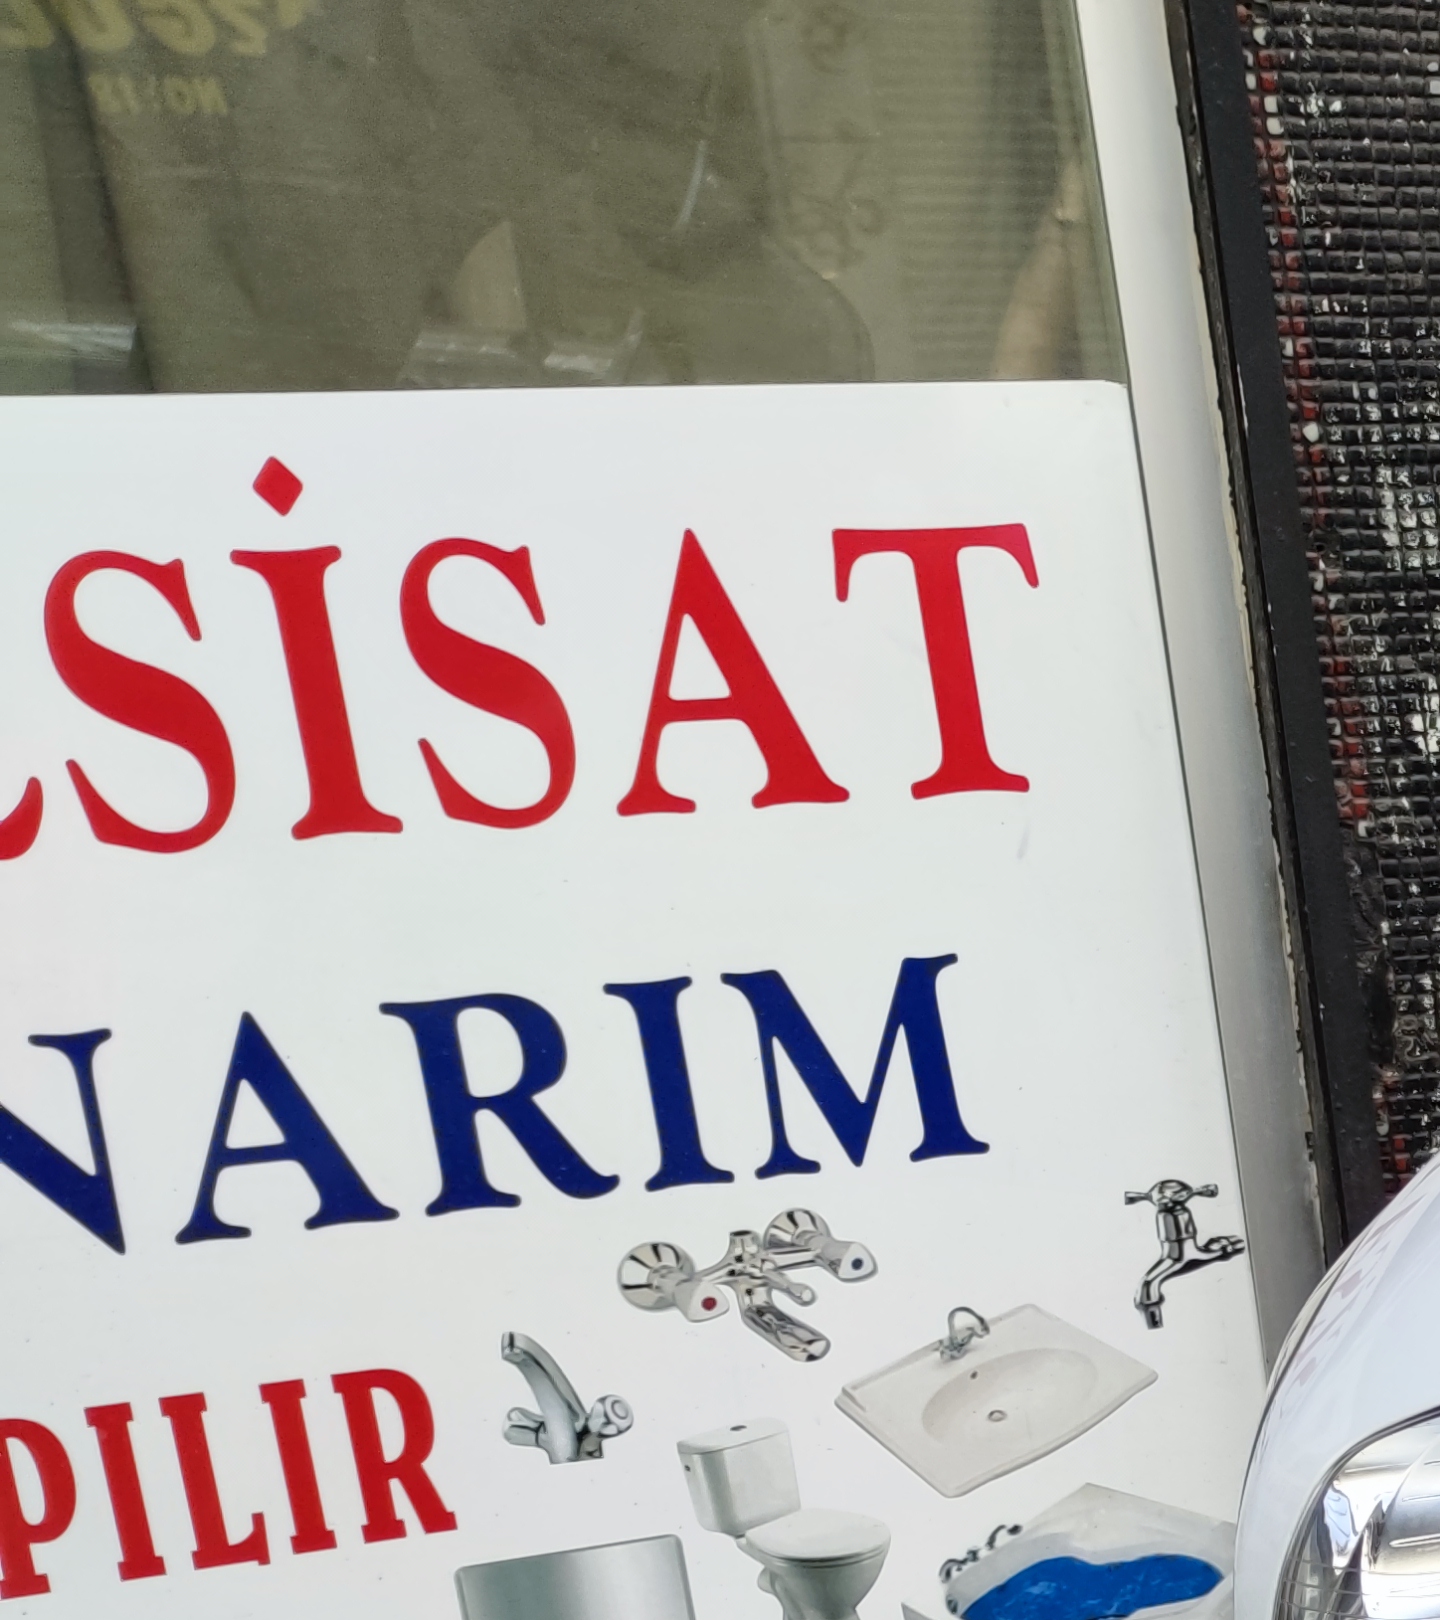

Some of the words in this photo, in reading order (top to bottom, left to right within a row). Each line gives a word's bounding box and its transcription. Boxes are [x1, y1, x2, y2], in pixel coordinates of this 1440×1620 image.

[0, 456, 1039, 861] SİSAT
[0, 953, 990, 1255] NARIM
[0, 1368, 458, 1600] PILIR
